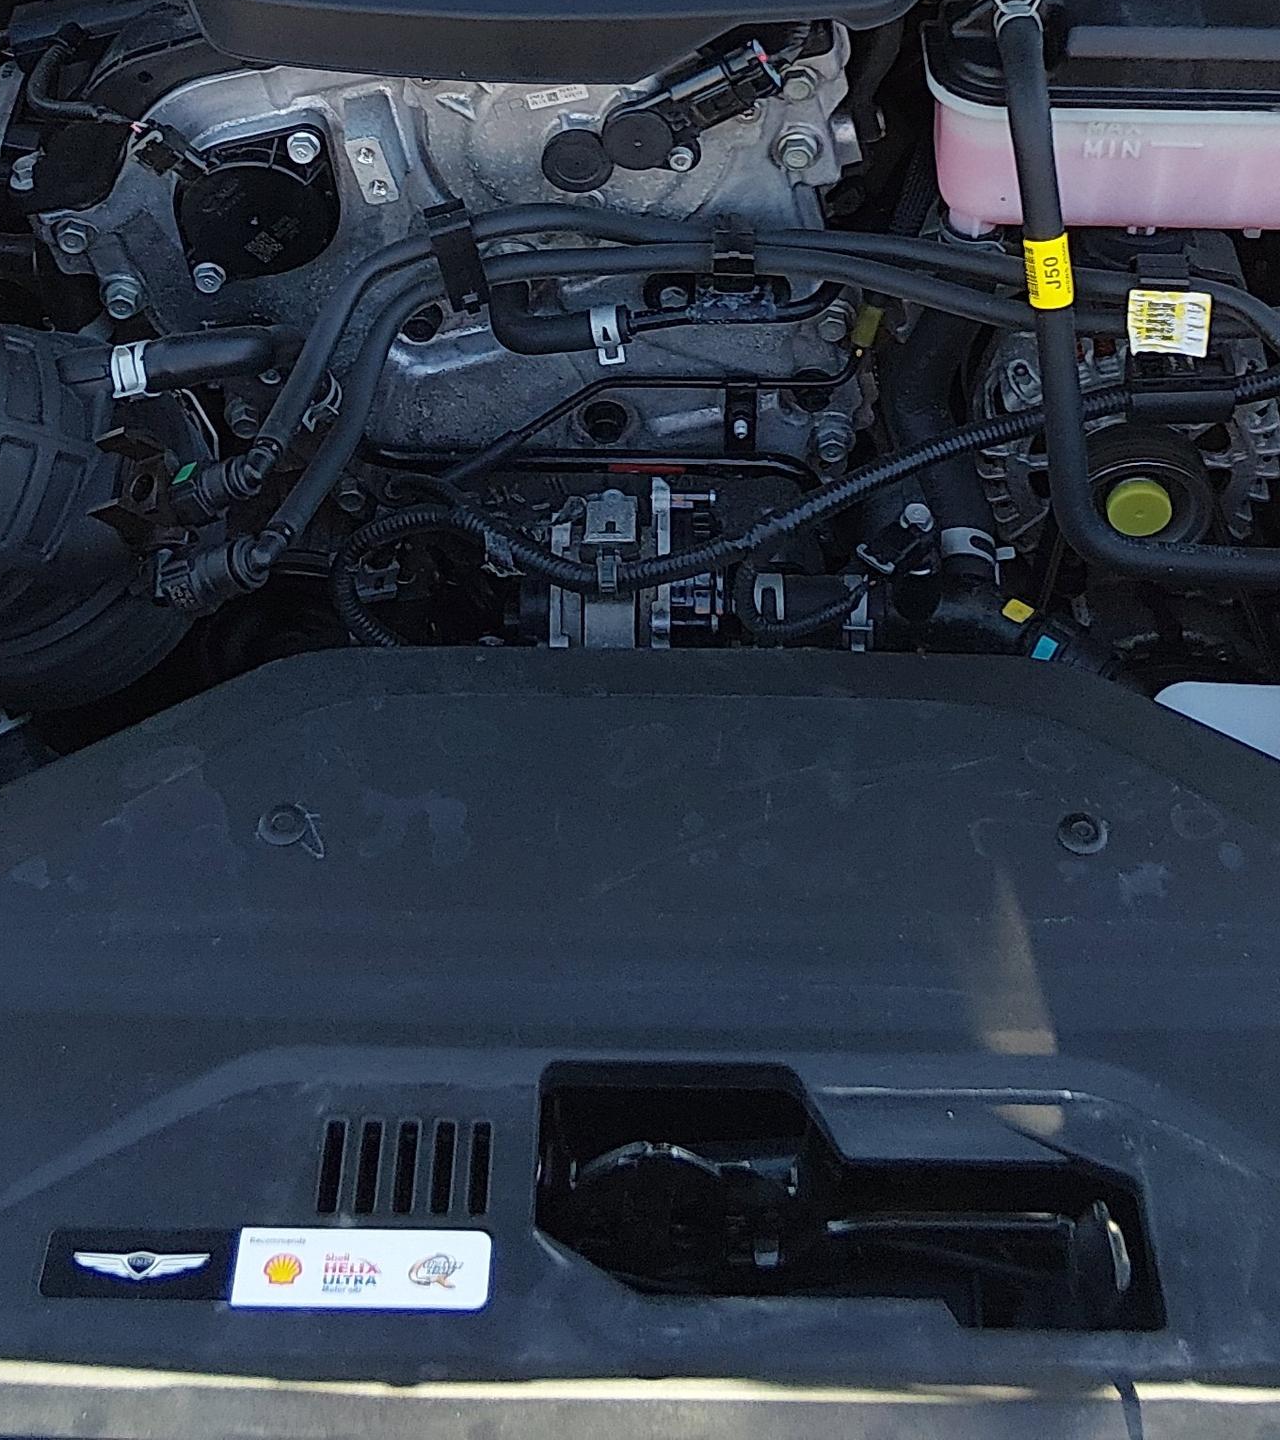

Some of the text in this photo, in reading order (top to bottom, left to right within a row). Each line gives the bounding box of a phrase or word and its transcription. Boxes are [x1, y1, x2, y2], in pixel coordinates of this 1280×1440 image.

[1084, 139, 1142, 159] MIN
[1042, 256, 1062, 290] J50
[323, 1262, 380, 1274] HELIX
[322, 1274, 377, 1285] ULTRA
